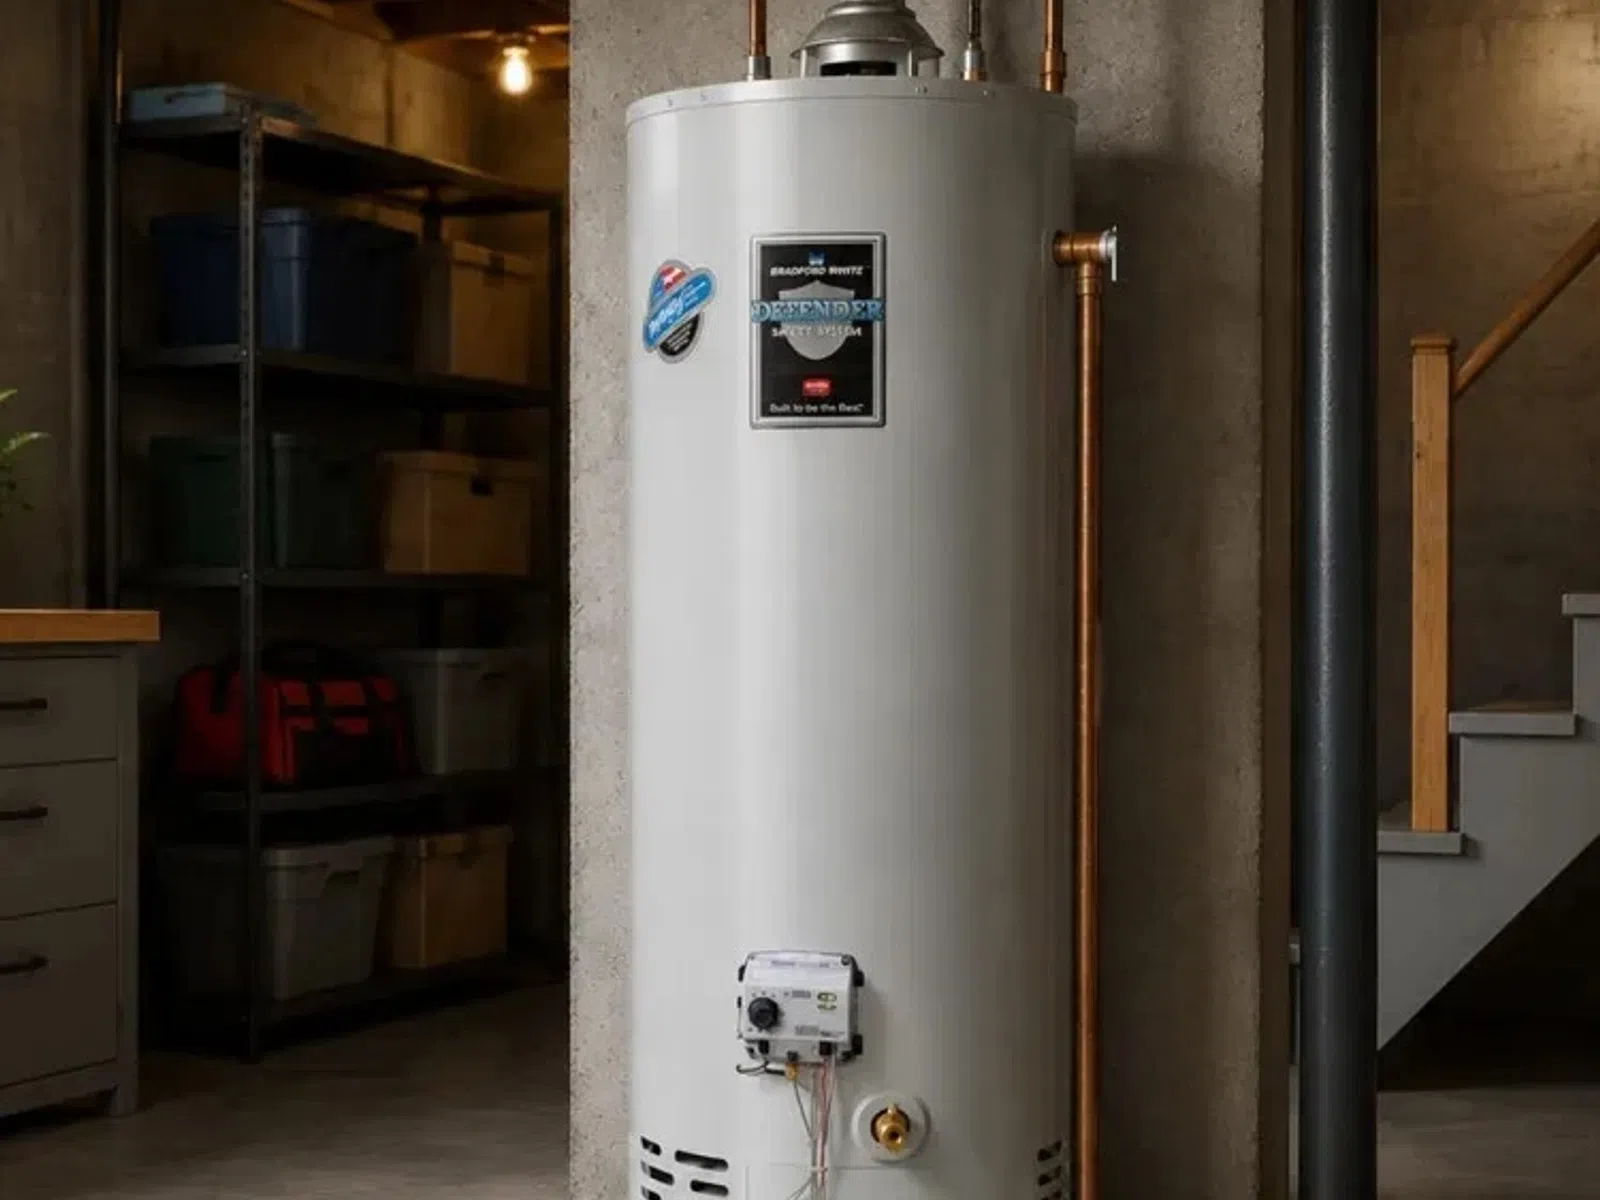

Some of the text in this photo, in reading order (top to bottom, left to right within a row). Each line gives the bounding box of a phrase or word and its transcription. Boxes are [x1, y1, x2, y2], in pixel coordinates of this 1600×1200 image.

[770, 266, 826, 276] BRADFORD
[751, 299, 884, 323] DEFENDER
[793, 403, 803, 413] to
[805, 403, 817, 412] be
[821, 403, 836, 412] the
